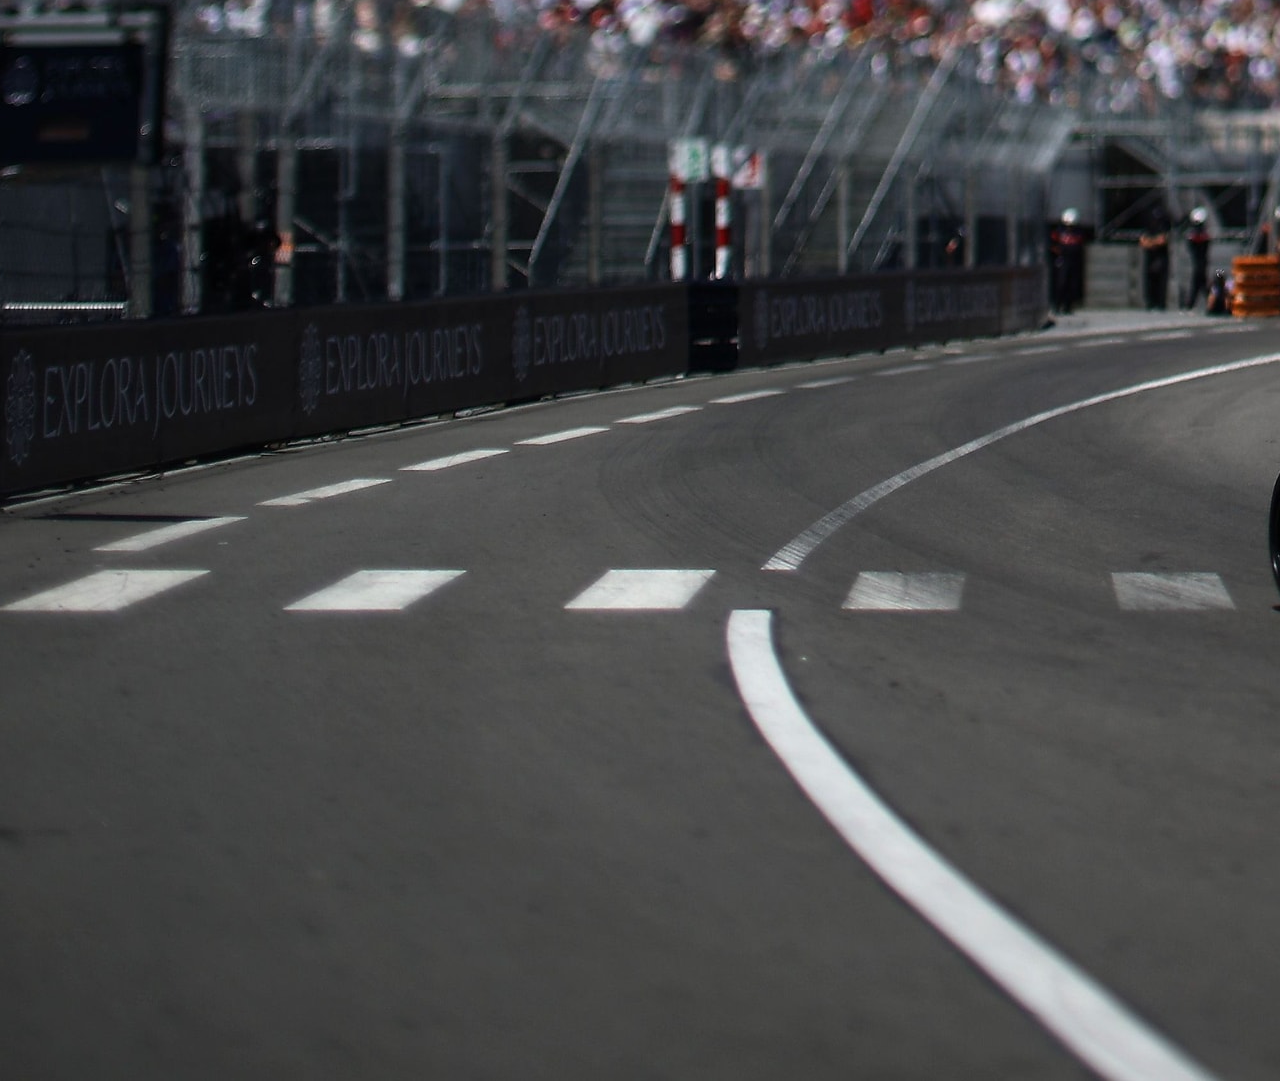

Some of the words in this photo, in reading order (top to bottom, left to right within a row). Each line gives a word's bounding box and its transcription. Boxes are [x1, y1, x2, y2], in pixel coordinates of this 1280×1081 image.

[326, 333, 401, 395] EXPLORA
[403, 324, 483, 398] JOURNEYS
[533, 312, 600, 366] EXPLORA
[598, 305, 666, 371] JOURNEYS
[42, 356, 149, 439] EXPLORA
[151, 342, 259, 441] JOURNEYS
